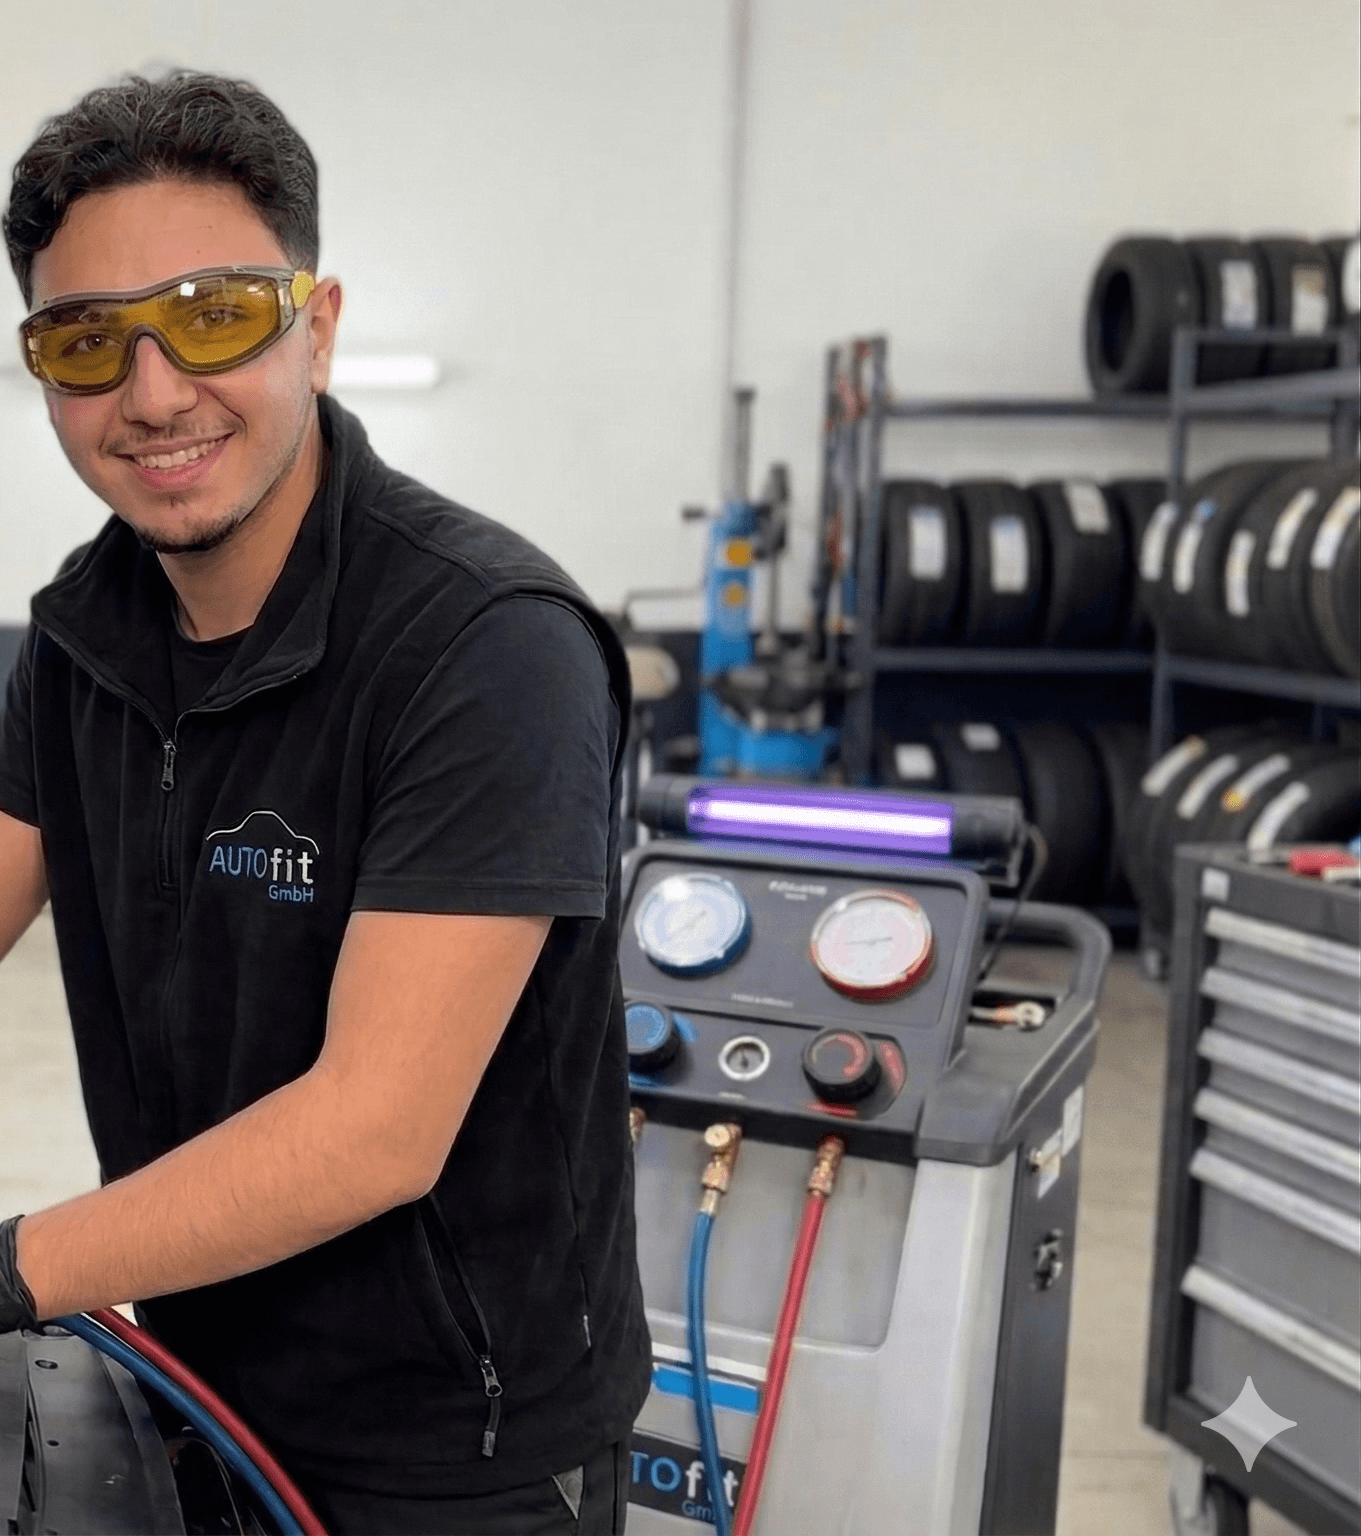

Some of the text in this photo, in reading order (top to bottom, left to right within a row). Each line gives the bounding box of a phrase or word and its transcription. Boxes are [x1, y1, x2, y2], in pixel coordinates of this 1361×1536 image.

[208, 845, 315, 885] AUTOfit
[268, 885, 315, 903] GmbH
[630, 1450, 739, 1508] TOft
[682, 1499, 716, 1521] Gm
